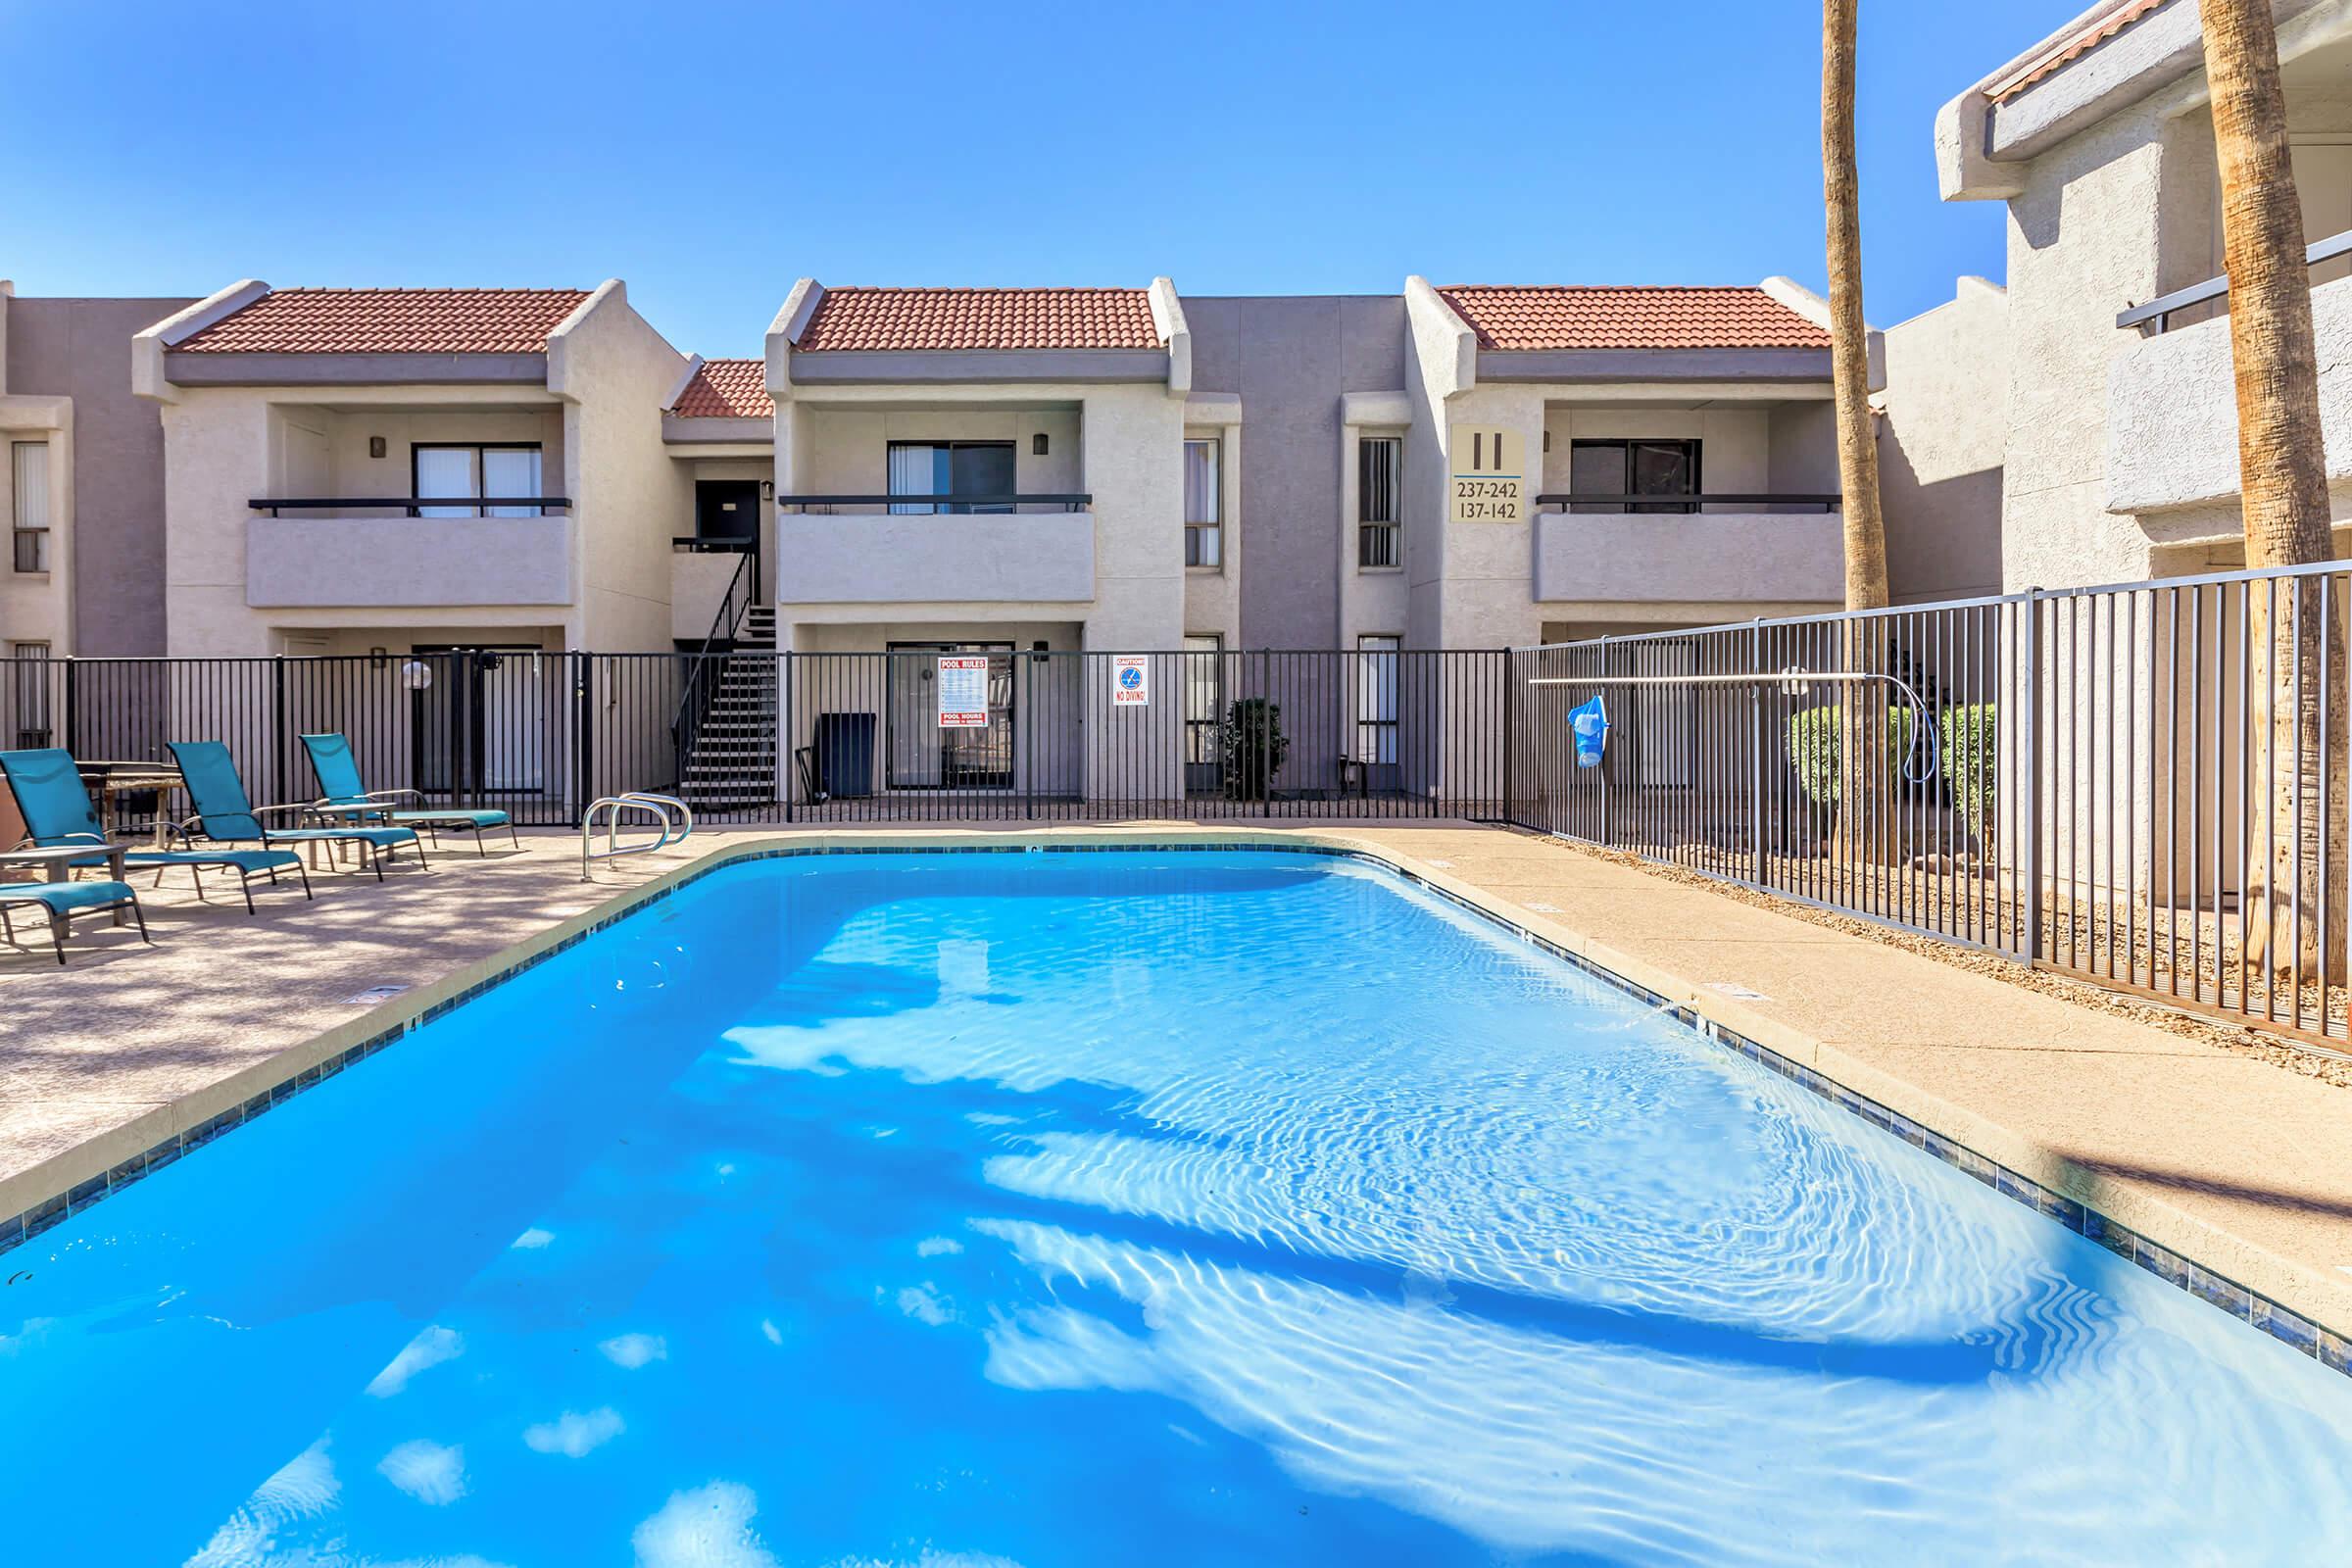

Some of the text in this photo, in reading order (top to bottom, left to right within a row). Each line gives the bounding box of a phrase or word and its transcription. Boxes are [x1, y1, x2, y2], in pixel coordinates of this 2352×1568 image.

[1457, 482, 1517, 498] 237-242
[1460, 503, 1516, 518] 137-142
[942, 660, 985, 668] POOL RULES
[1116, 691, 1125, 701] NO
